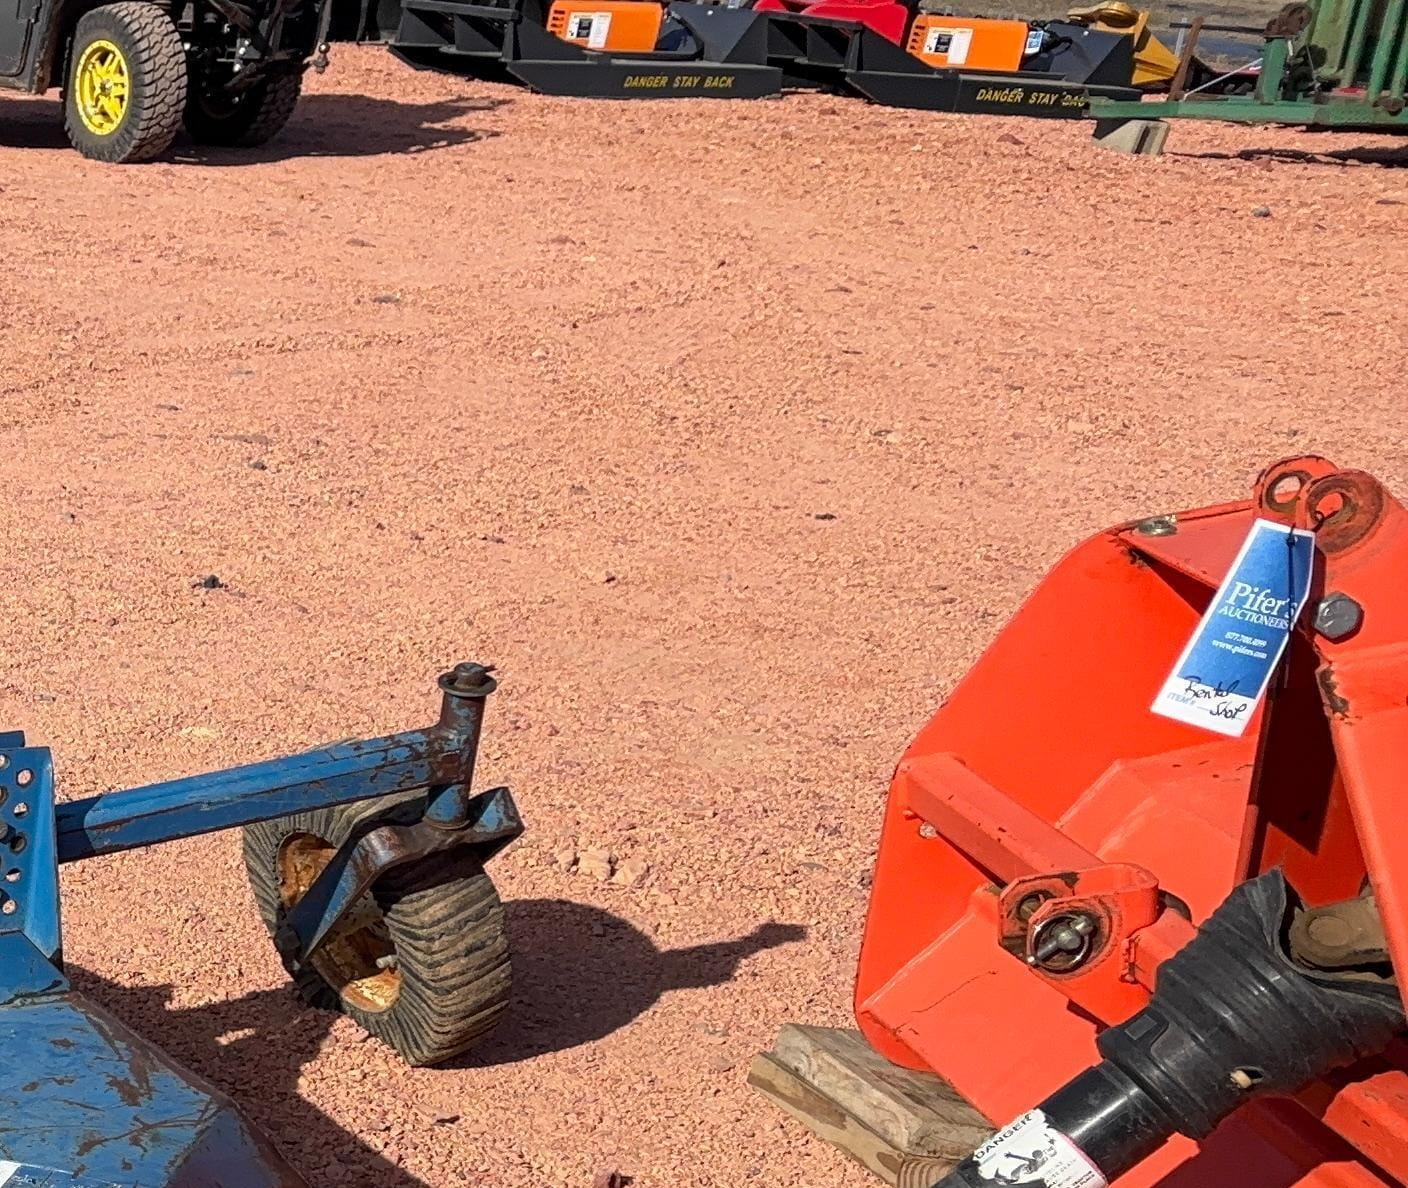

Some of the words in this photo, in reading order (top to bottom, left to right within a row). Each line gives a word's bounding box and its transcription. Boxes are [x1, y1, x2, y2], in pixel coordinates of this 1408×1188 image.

[623, 76, 669, 89] DANGER
[672, 76, 701, 89] STAY
[703, 76, 735, 89] BACK
[975, 88, 1025, 103] DANGER
[1028, 92, 1059, 105] STAY
[1218, 606, 1290, 630] AUCTIONEERS
[975, 1112, 1032, 1159] DANGER
